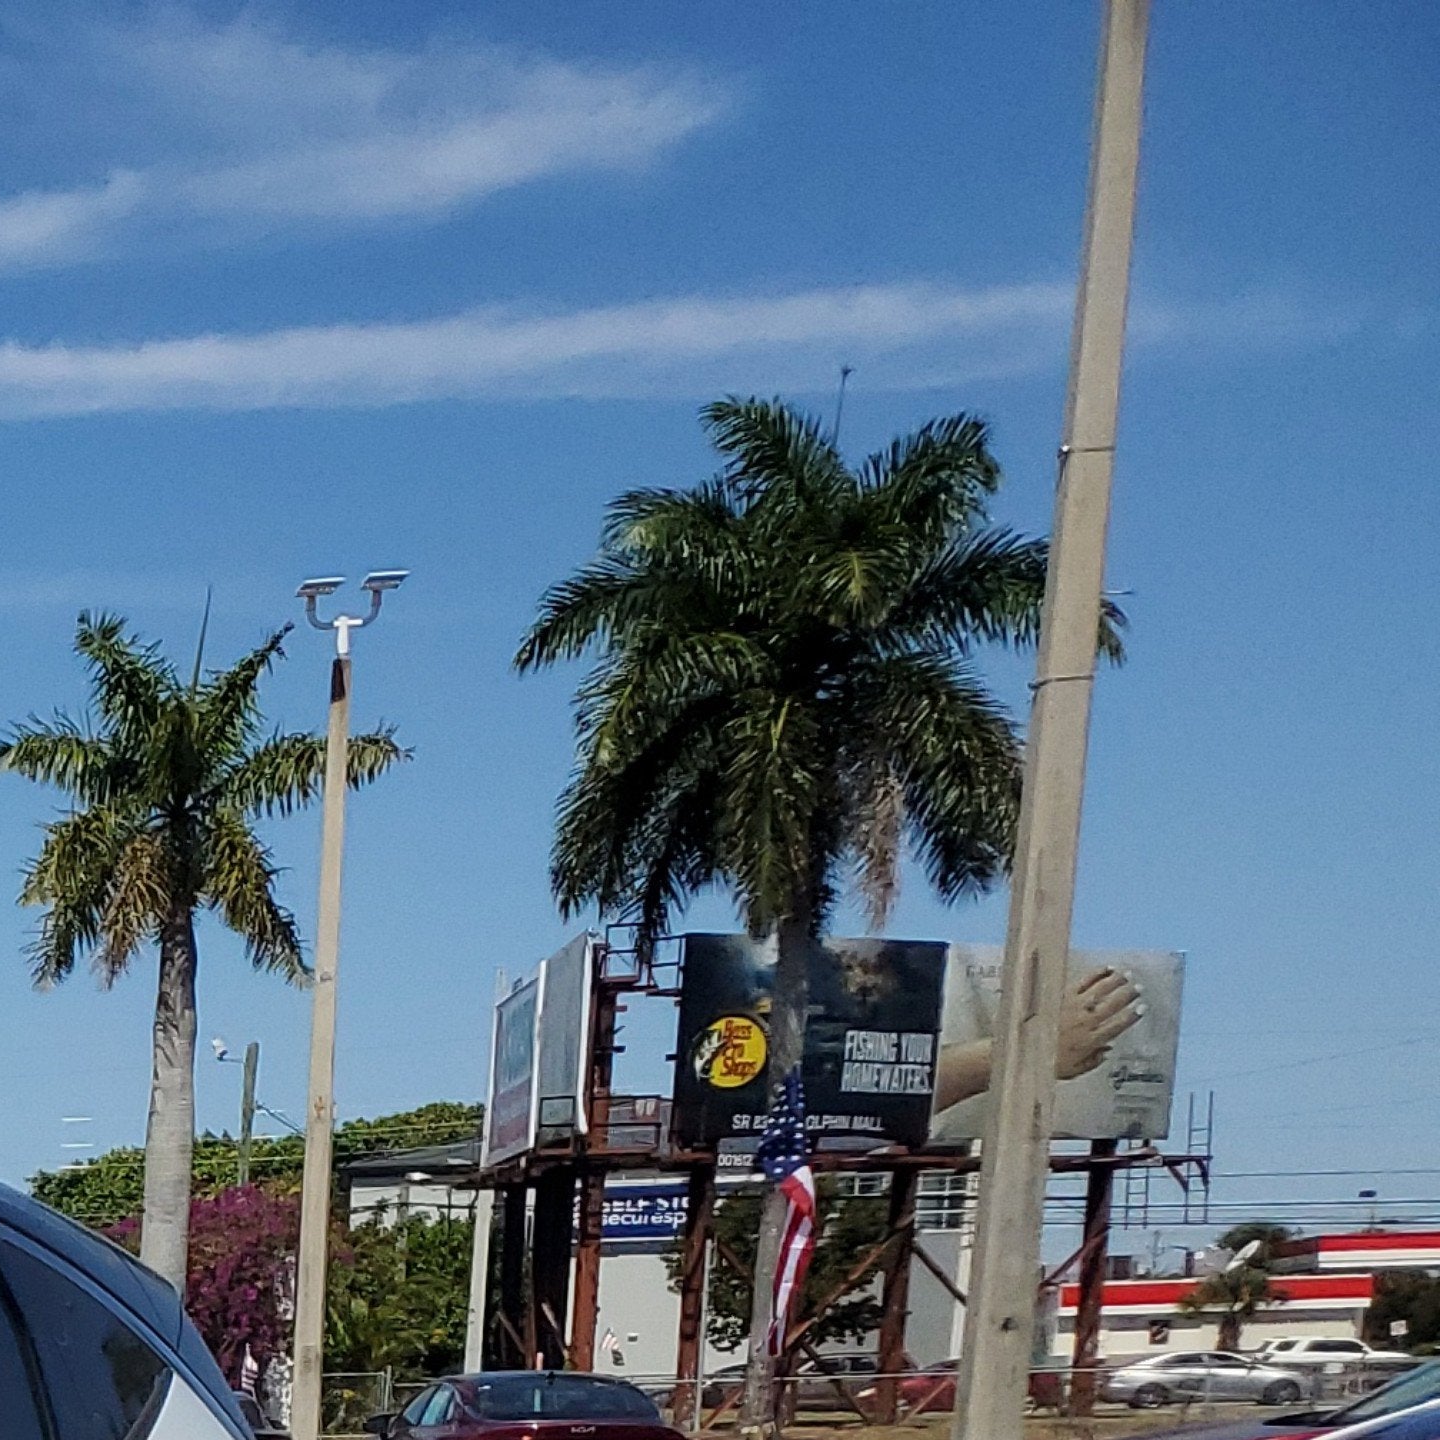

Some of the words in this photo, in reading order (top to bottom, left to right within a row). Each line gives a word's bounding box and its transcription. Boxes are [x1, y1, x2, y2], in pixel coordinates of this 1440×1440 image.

[844, 1030, 898, 1062] FISHING
[901, 1033, 934, 1062] YOUR
[732, 1114, 750, 1130] SR
[806, 1115, 851, 1130] OLPHIN
[852, 1116, 885, 1131] MALL
